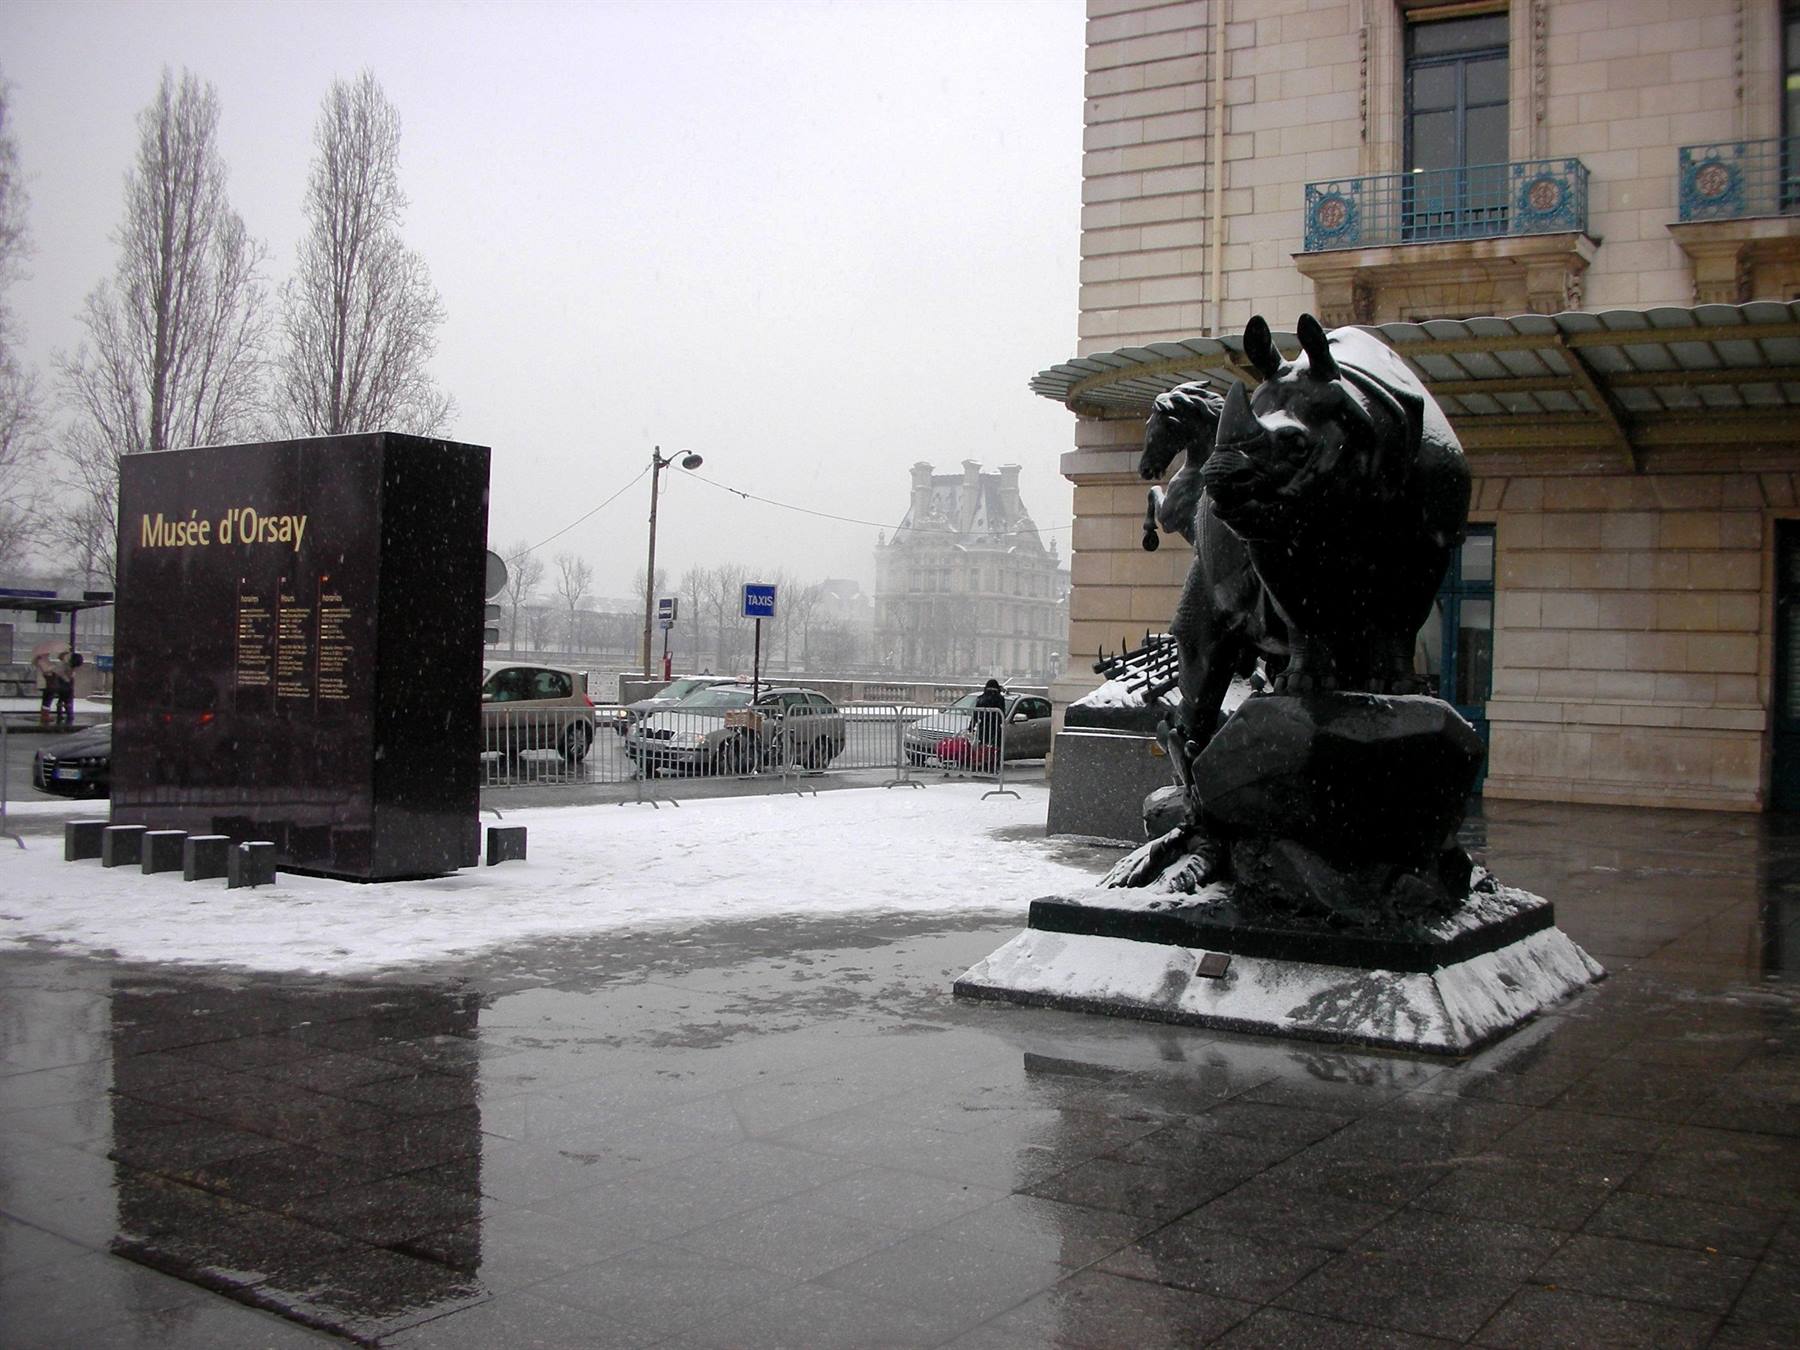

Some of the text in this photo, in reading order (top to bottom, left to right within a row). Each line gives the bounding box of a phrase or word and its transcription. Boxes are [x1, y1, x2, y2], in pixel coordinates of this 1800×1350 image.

[142, 507, 307, 552] Musée d'Orsay
[748, 595, 773, 606] TAXIS
